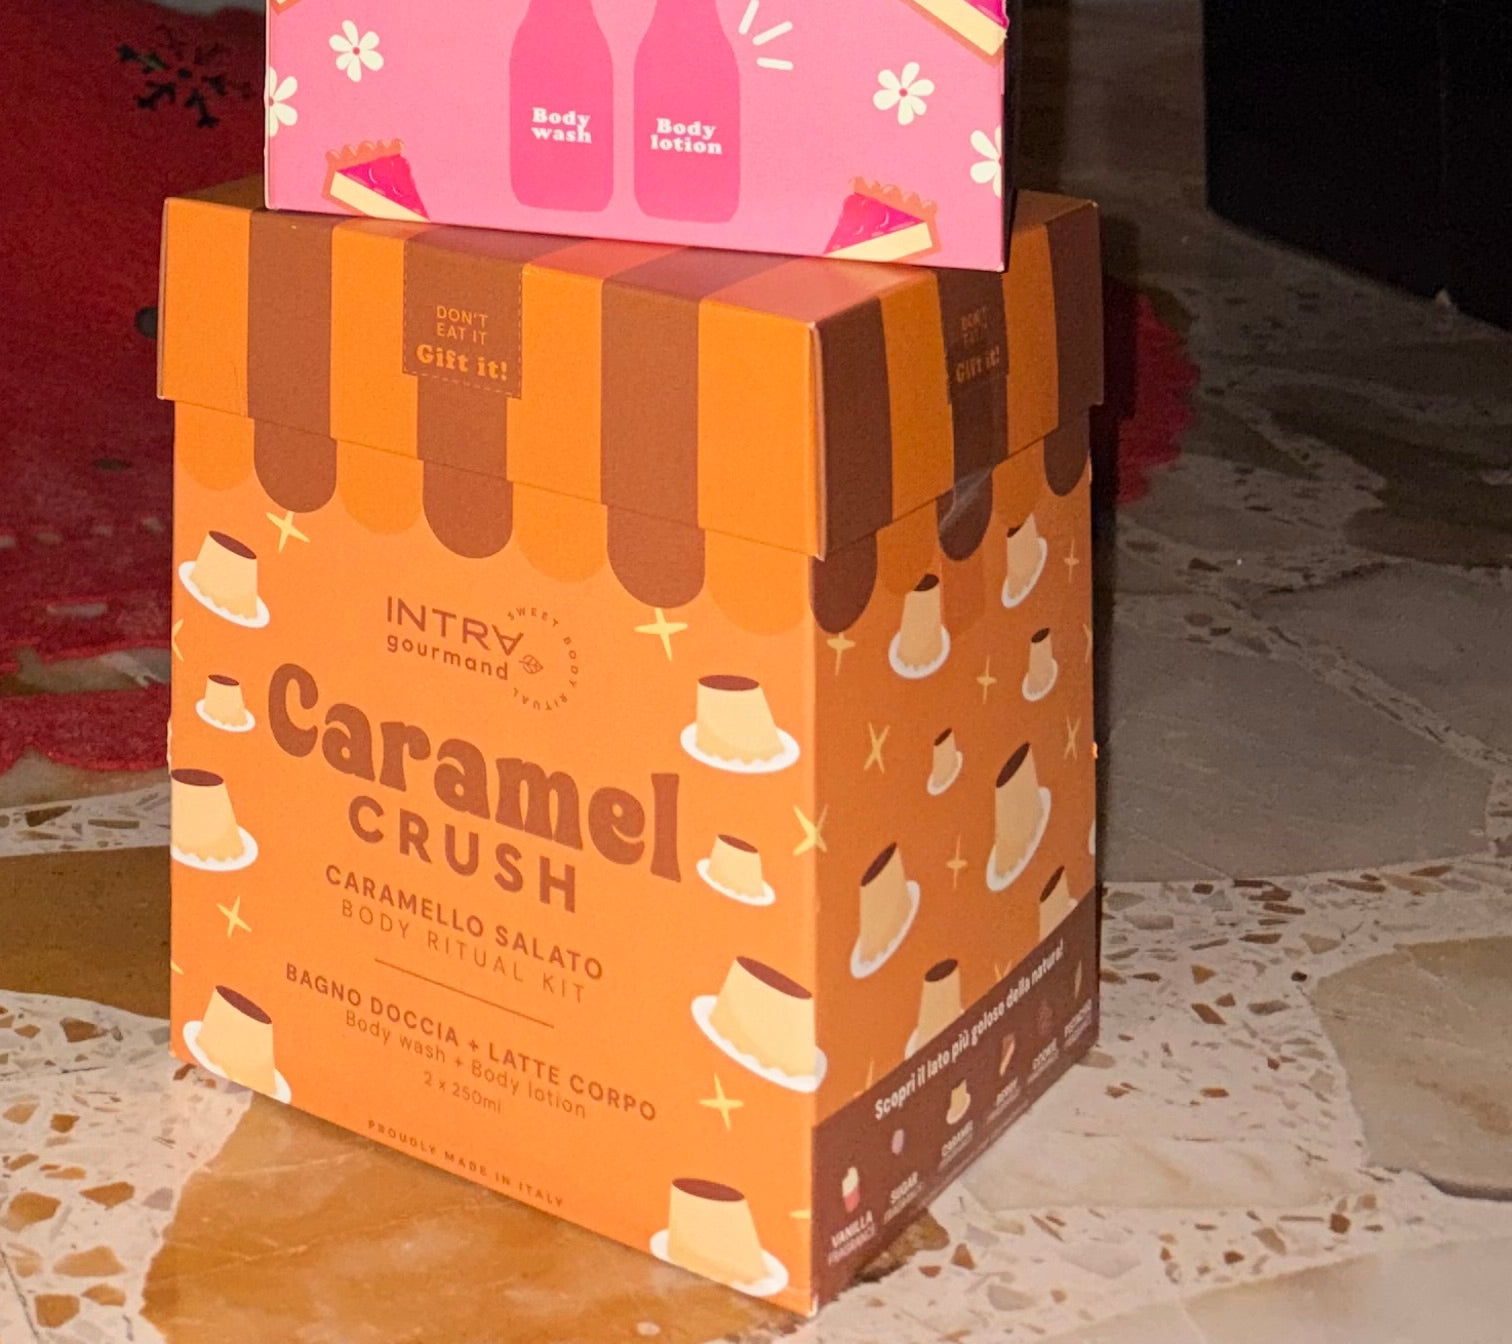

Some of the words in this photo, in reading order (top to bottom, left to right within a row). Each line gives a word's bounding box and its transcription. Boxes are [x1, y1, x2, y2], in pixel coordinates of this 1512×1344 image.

[531, 126, 591, 144] wash
[532, 107, 591, 129] Body
[657, 118, 716, 140] Body
[650, 135, 722, 154] lotion
[437, 305, 488, 328] DON'T
[437, 322, 466, 341] EAT
[472, 330, 487, 345] IT
[416, 344, 468, 372] Gift
[477, 356, 507, 381] it!
[507, 607, 560, 628] SWEET
[387, 634, 509, 681] gourmand
[562, 636, 579, 689] BODY
[512, 687, 569, 711] RITUAL
[268, 663, 681, 883] Caramel
[348, 795, 575, 913] CRUSH
[325, 864, 485, 938] CARAMELLO
[495, 924, 603, 980] SALATO
[341, 899, 409, 939] BODY
[427, 930, 524, 983] RITUAL
[543, 972, 585, 1003] KIT
[286, 962, 362, 1007] BAGNO
[370, 995, 459, 1048] DOCCIA
[468, 1039, 479, 1051] +
[489, 1042, 560, 1085] LATTE
[569, 1073, 657, 1121] CORPO
[345, 1009, 391, 1046] Body
[400, 1035, 445, 1063] wash
[454, 1057, 464, 1067] +
[471, 1059, 520, 1095] Body
[528, 1083, 586, 1119] lotion
[875, 1073, 916, 1120] Scopri
[917, 1064, 926, 1088] il
[927, 1049, 950, 1079] lato
[951, 1029, 969, 1063] più
[971, 1001, 1006, 1046] goloso
[1006, 976, 1031, 1008] della
[423, 1070, 433, 1087] 2
[438, 1079, 446, 1091] x
[451, 1081, 502, 1115] 250ml
[368, 1120, 437, 1154] PROUDLY
[444, 1150, 488, 1176] MADE
[495, 1166, 511, 1186] IN
[518, 1180, 564, 1207] ITALY
[831, 1210, 873, 1249] VANILLA
